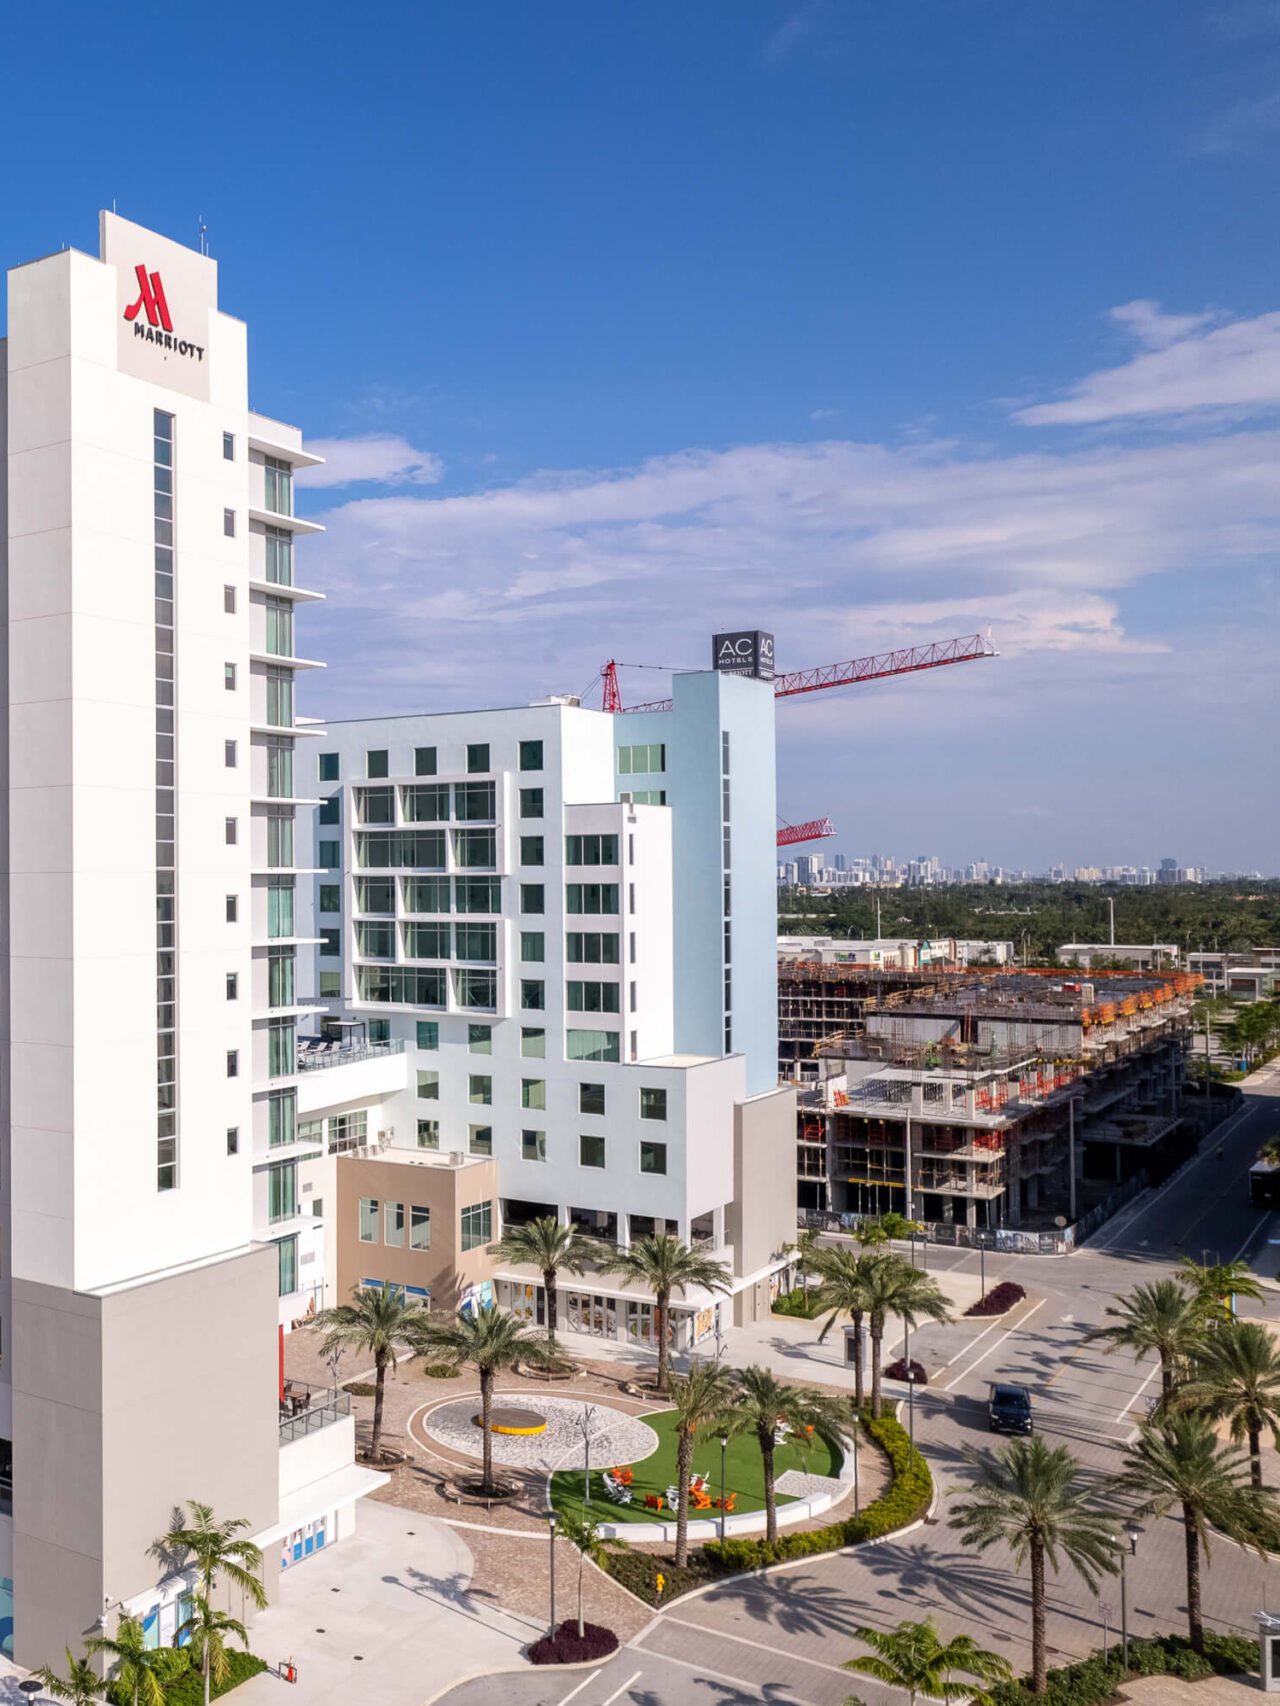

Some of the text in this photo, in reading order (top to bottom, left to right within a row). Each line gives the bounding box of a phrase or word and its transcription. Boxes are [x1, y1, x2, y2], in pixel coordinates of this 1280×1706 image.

[134, 321, 205, 362] MARRIOTT
[719, 638, 752, 657] AC
[760, 638, 773, 657] AC
[718, 656, 753, 665] HOTELS
